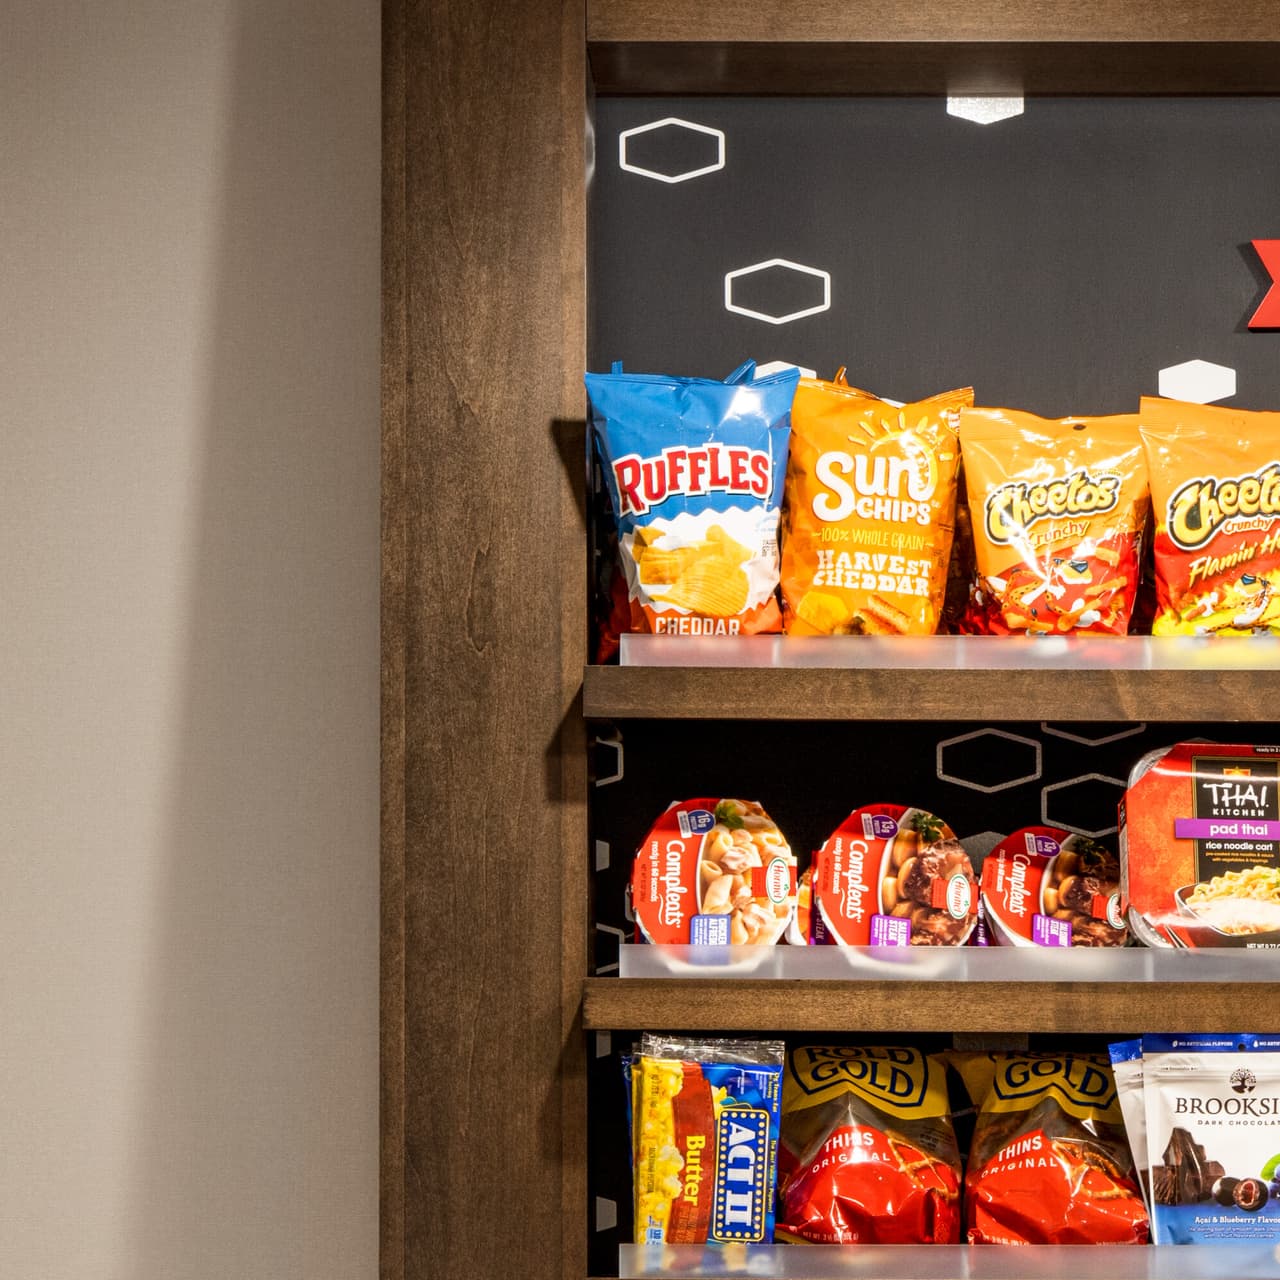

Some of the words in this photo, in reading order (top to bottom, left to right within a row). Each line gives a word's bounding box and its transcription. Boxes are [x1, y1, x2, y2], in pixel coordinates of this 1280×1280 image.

[613, 446, 771, 513] RUFFLES
[856, 498, 932, 526] CHIPS
[987, 474, 1119, 542] Cheetos
[821, 527, 849, 543] 100%
[852, 530, 889, 547] WHOLE
[891, 533, 926, 551] GRAIN
[1224, 517, 1272, 534] Crunchy
[817, 550, 932, 578] HARVEST
[813, 571, 930, 596] CHEDDAR
[655, 616, 741, 635] CHEDDAR
[1202, 782, 1268, 808] THAI
[1212, 808, 1265, 817] KITCHEN
[1210, 823, 1238, 836] pad
[1242, 823, 1268, 836] thai
[1205, 842, 1222, 850] rice
[1224, 842, 1253, 850] noodle
[1255, 843, 1273, 851] cart
[659, 839, 688, 928] Compleats
[842, 839, 869, 923] Compleats
[1005, 853, 1031, 917] Compleats
[811, 1060, 914, 1097] GOLD
[1005, 1060, 1110, 1097] GOLD
[726, 1122, 756, 1185] ACT
[824, 1132, 875, 1153] THINS
[998, 1135, 1043, 1162] THINS
[683, 1135, 706, 1206] Butter
[981, 1157, 1058, 1179] ORIGINAL
[724, 1190, 754, 1226] II
[1219, 1216, 1256, 1225] Blueberry
